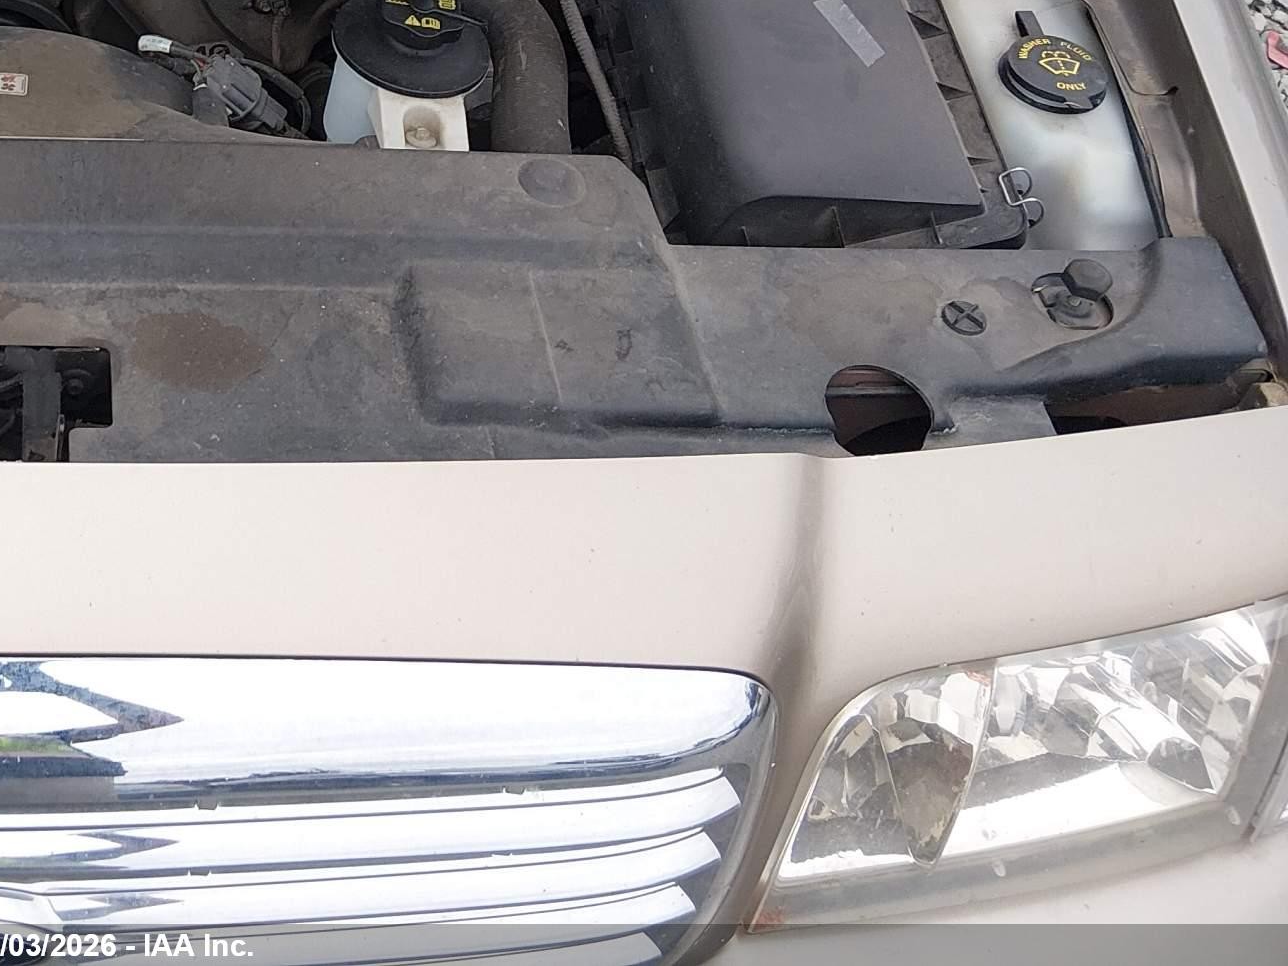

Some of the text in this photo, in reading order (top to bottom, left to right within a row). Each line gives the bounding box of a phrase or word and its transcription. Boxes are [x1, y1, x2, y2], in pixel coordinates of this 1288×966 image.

[1017, 38, 1092, 62] WASHER FLUID
[1056, 81, 1087, 91] ONLY
